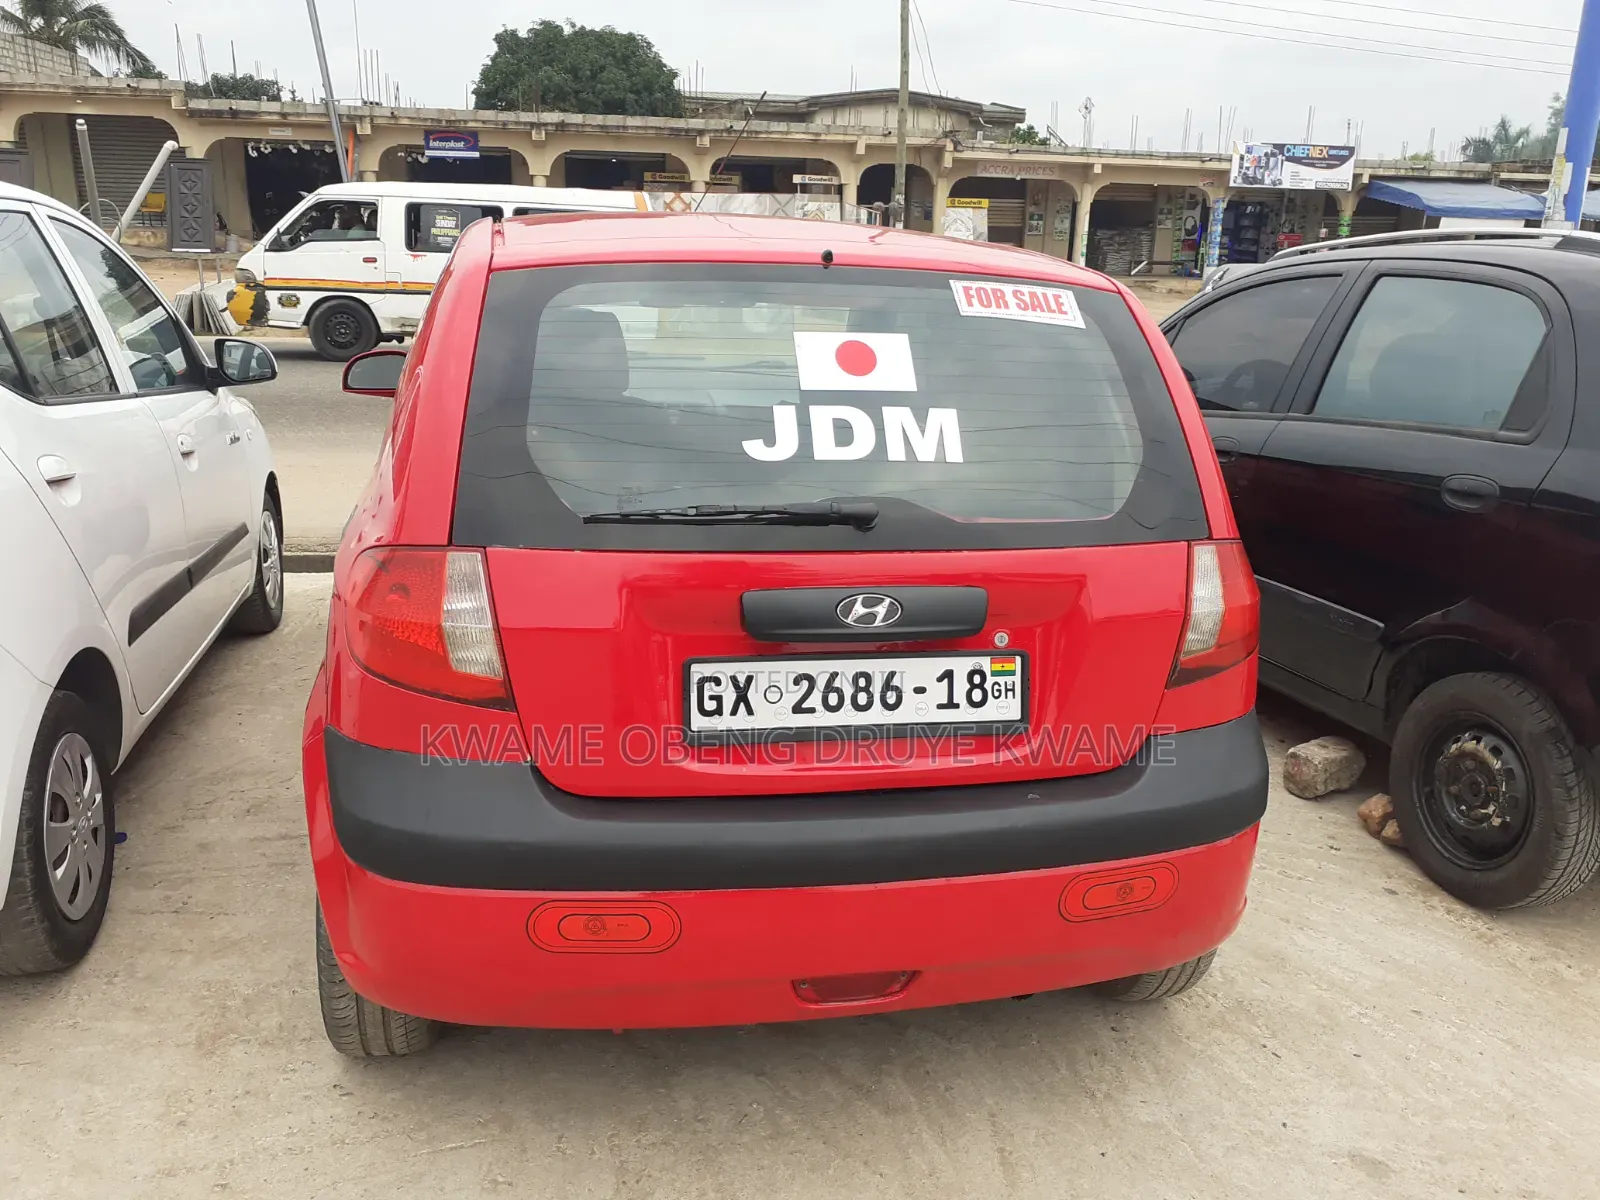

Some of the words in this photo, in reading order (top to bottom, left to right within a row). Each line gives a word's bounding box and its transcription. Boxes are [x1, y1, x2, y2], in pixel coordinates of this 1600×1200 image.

[429, 140, 465, 148] Interplast
[1284, 145, 1328, 158] CHIEFNEX
[981, 164, 1014, 174] ACCRA
[1018, 165, 1055, 176] PRICES
[962, 286, 1010, 310] FOR
[1012, 289, 1068, 315] SALE
[741, 405, 964, 463] JDM
[696, 674, 755, 717] GX
[991, 680, 1016, 700] GH
